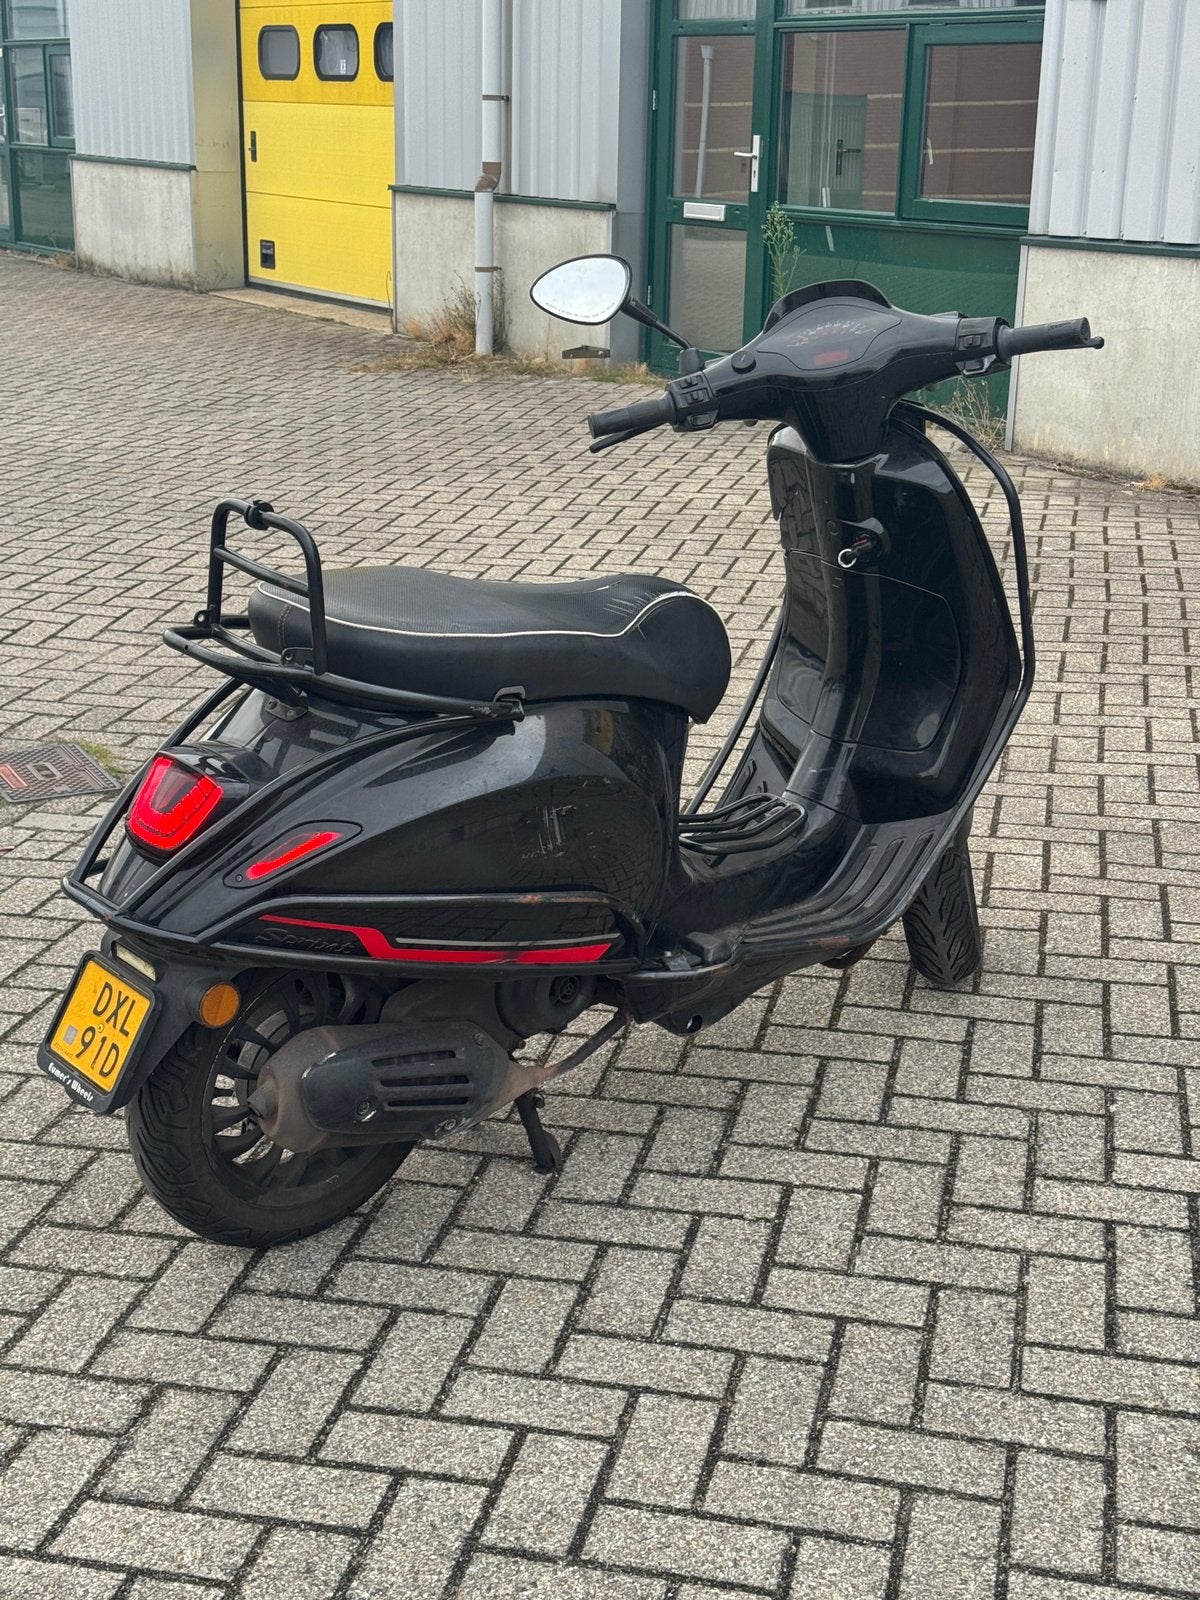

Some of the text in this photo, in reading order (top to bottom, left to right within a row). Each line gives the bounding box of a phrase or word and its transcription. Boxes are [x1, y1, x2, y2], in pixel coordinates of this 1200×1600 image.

[255, 927, 355, 954] Sprint
[93, 981, 136, 1038] DXL
[75, 1026, 120, 1077] 91D
[71, 1079, 94, 1102] Wheels
